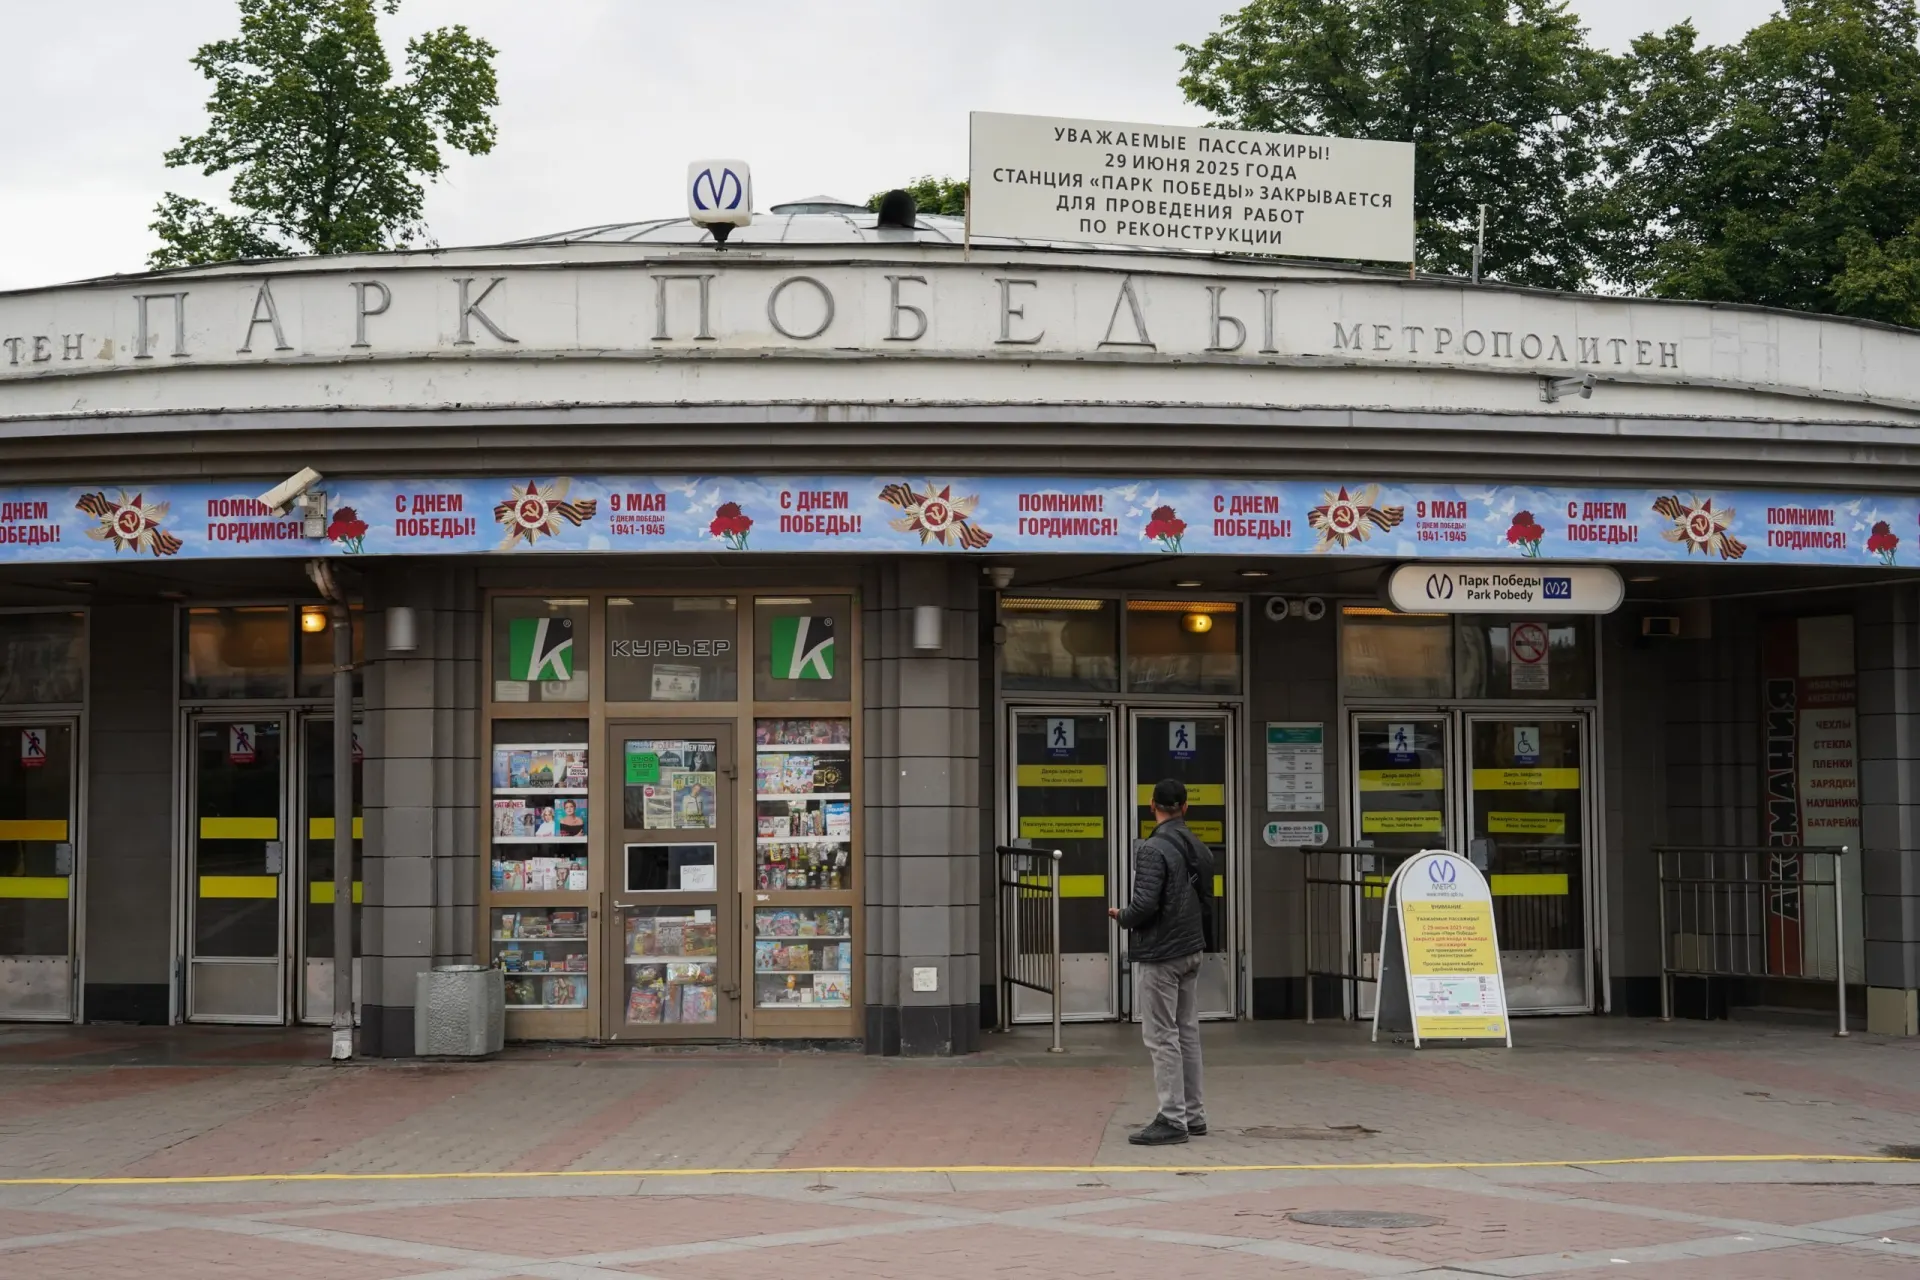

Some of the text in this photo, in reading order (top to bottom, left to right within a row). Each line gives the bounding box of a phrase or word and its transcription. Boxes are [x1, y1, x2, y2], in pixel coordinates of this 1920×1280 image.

[1054, 126, 1331, 161] УВАЖАЕМЫЕ ПАССАЖИРЫ!
[1105, 152, 1298, 181] 29 ИЮНЯ 2025 ГОДА
[993, 167, 1393, 209] СТАНЦИЯ «ПАРК ПОБЕДЫ» ЗАКРЫВАЕТСЯ
[1056, 194, 1305, 225] ДЛЯ ПРОВЕДЕНИЯ РАБОТ
[1080, 218, 1283, 246] ПО РЕКОНСТРУКЦИИ
[133, 273, 1279, 360] ПАРК ПОБЕДЫ
[3, 333, 85, 364] ТЕН
[1332, 321, 1680, 369] МЕТРОПОЛИТЕН
[1, 501, 48, 523] ДНЕМ
[395, 493, 463, 516] С ДНЕМ
[610, 493, 666, 512] 9 МАЯ
[780, 490, 849, 513] С ДНЕМ
[1018, 493, 1104, 513] ПОМНИМ!
[1214, 494, 1279, 516] С ДНЕМ
[1416, 500, 1467, 519] 9 МАЯ
[1568, 501, 1627, 521] С ДНЕМ
[395, 516, 476, 538] ПОБЕДЫ!
[616, 515, 635, 523] ДНЕМ
[636, 515, 665, 523] ПОБЕДЫ!
[780, 513, 862, 535] ПОБЕДЫ!
[1018, 516, 1118, 539] ГОРДИМСЯ!
[1422, 522, 1439, 530] ДНЕМ
[1767, 507, 1834, 526] ПОМНИМ!
[208, 521, 304, 544] ГОРДИМСЯ!
[610, 523, 665, 535] 1941-1945
[1214, 517, 1292, 540] ПОБЕДЫ!
[1416, 530, 1467, 542] 1941-1945
[1568, 523, 1638, 545] ПОБЕДЫ!
[1768, 529, 1847, 550] ГОРДИМСЯ!
[1459, 574, 1541, 589] Парк Победы
[1467, 588, 1534, 603] Park Pobedy
[611, 639, 731, 657] КУРЬЕР
[1816, 720, 1851, 729] ЧЕХЛЫ
[1813, 739, 1852, 749] СТЕКЛА
[1812, 759, 1853, 769] ПЛЕНКИ
[1810, 779, 1856, 789] ЗАРЯДКИ
